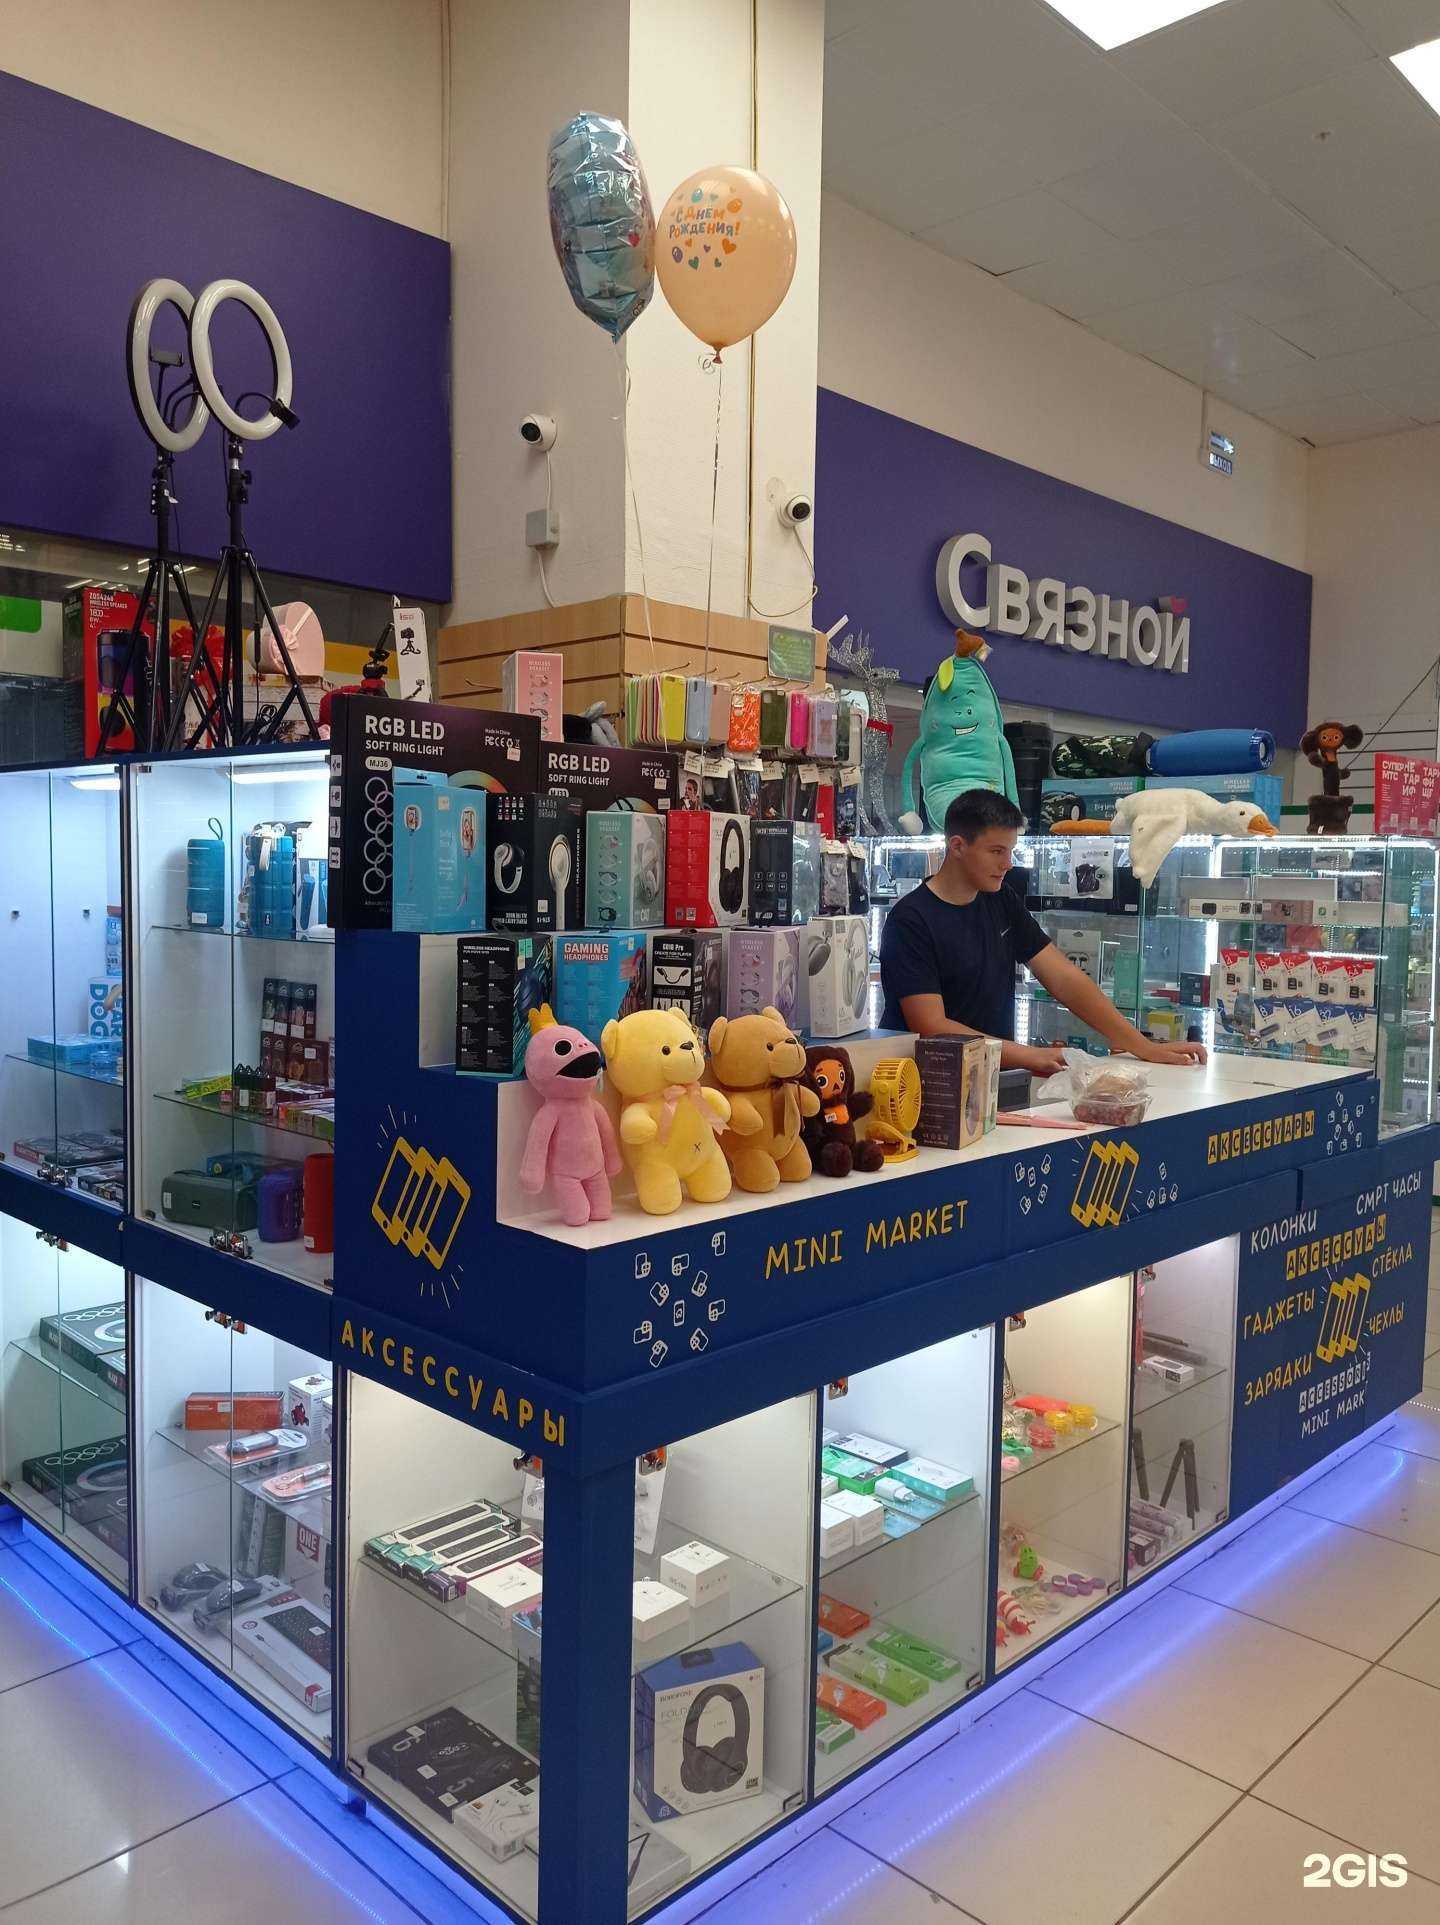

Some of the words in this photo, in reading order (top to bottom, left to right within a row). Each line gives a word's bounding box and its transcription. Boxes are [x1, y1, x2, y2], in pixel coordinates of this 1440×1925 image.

[669, 221, 741, 239] РОЖДЕНИЯ!
[1210, 453, 1233, 474] ВЫХОД
[365, 714, 406, 737] RGB
[410, 719, 445, 741] LED
[365, 739, 391, 751] SOFT
[392, 742, 416, 754] RING
[417, 744, 445, 757] LIGHT
[369, 759, 389, 768] MJ36
[548, 752, 579, 771] RGB
[583, 755, 610, 773] LED
[1382, 760, 1404, 771] СУПЕР
[548, 773, 568, 784] SOFT
[569, 775, 588, 785] RING
[588, 776, 610, 787] LIGHT
[1382, 771, 1399, 781] МТС
[1403, 773, 1420, 785] ТАР
[564, 942, 609, 954] GAMING
[564, 953, 609, 961] HEADPHONES
[90, 983, 109, 1037] DOG
[1288, 1005, 1302, 1016] 16
[1319, 1009, 1331, 1020] 32
[1351, 1014, 1363, 1024] 64
[1207, 1110, 1315, 1164] АКСЕССУАРЫ
[1356, 1182, 1389, 1216] СМРТ
[1392, 1170, 1422, 1200] ЧАСЫ
[764, 1229, 843, 1280] MINI
[865, 1199, 969, 1254] MARKET
[1250, 1208, 1318, 1255] КОЛОНКИ
[1371, 1242, 1413, 1279] СТЁКЛА
[1243, 1288, 1316, 1340] ГАДЖЕТЫ
[1369, 1302, 1405, 1336] ЧЕХЛЫ
[341, 1319, 565, 1447] АКСЕССУАРЫ
[1244, 1352, 1313, 1406] ЗАРЯДКИ
[1301, 1408, 1330, 1440] MINI
[299, 1527, 318, 1551] ONE
